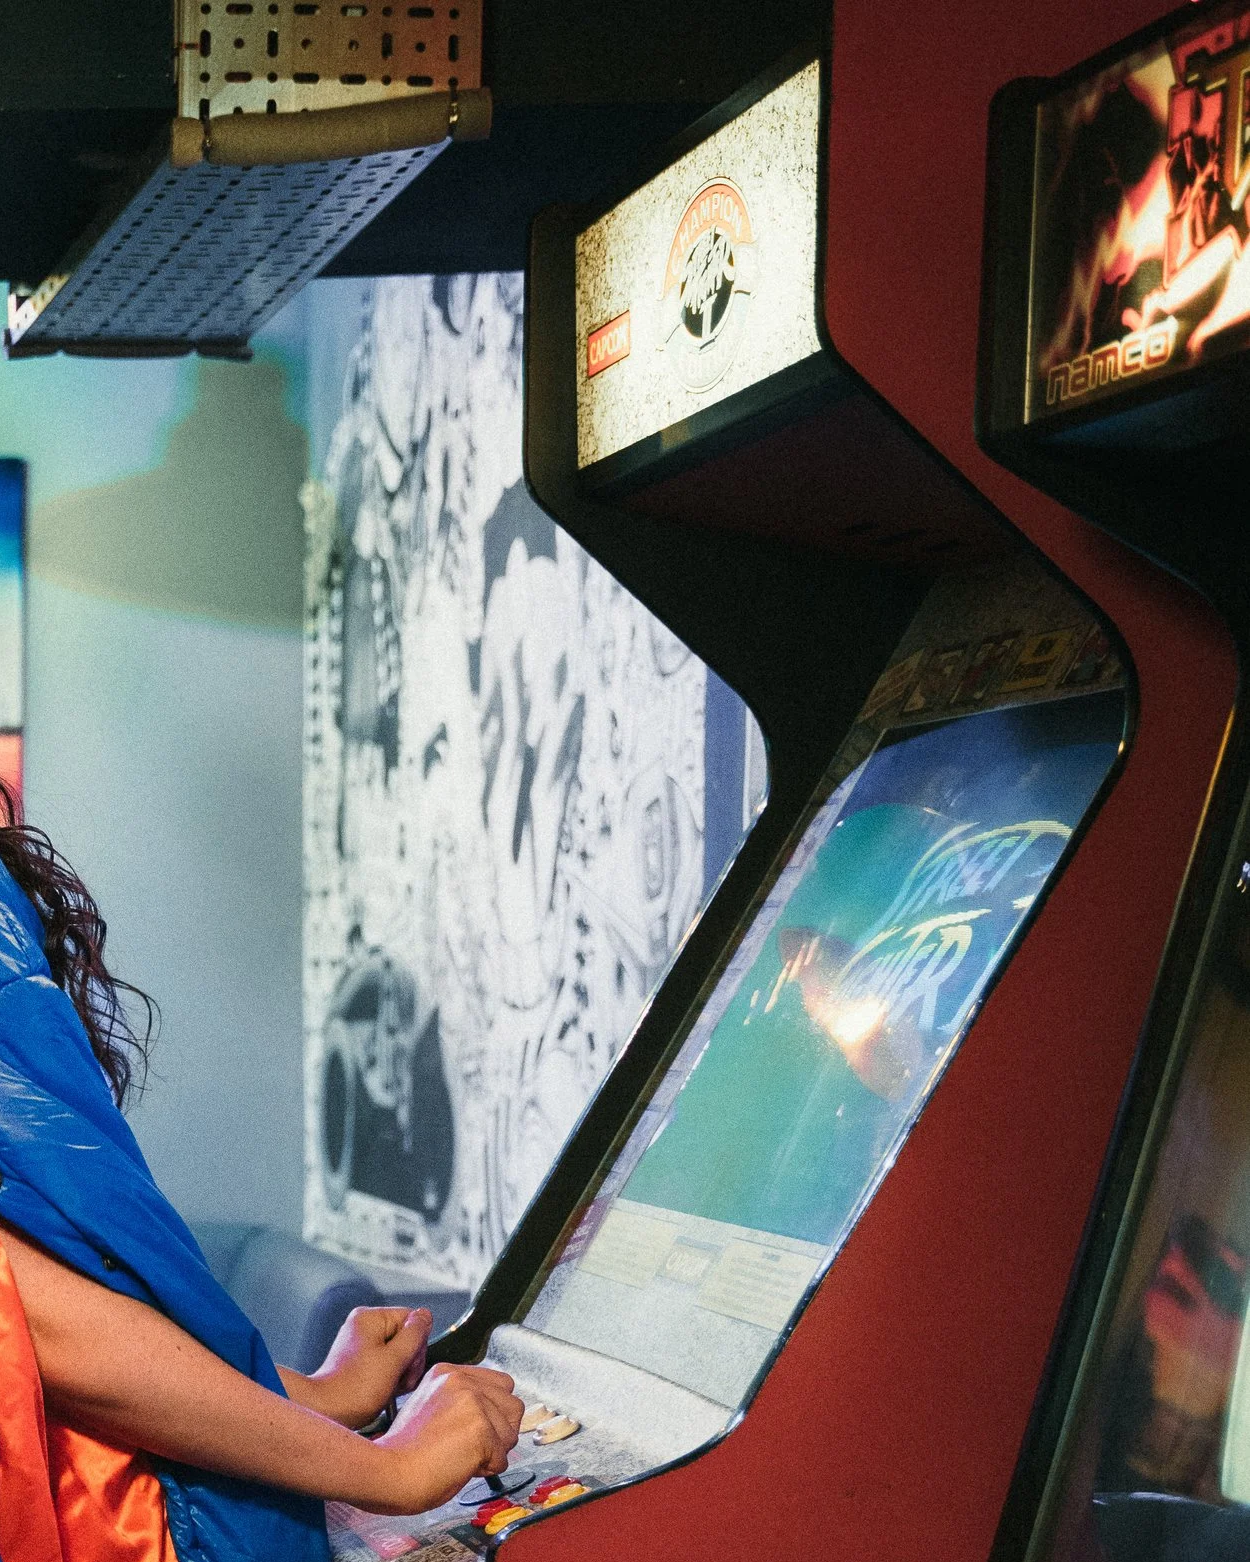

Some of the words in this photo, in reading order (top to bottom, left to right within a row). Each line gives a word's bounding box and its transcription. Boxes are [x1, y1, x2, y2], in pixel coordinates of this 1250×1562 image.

[671, 192, 744, 277] CHAMPION
[590, 323, 629, 365] CAPCOM
[1046, 316, 1179, 405] namco
[853, 820, 1075, 948] STREET
